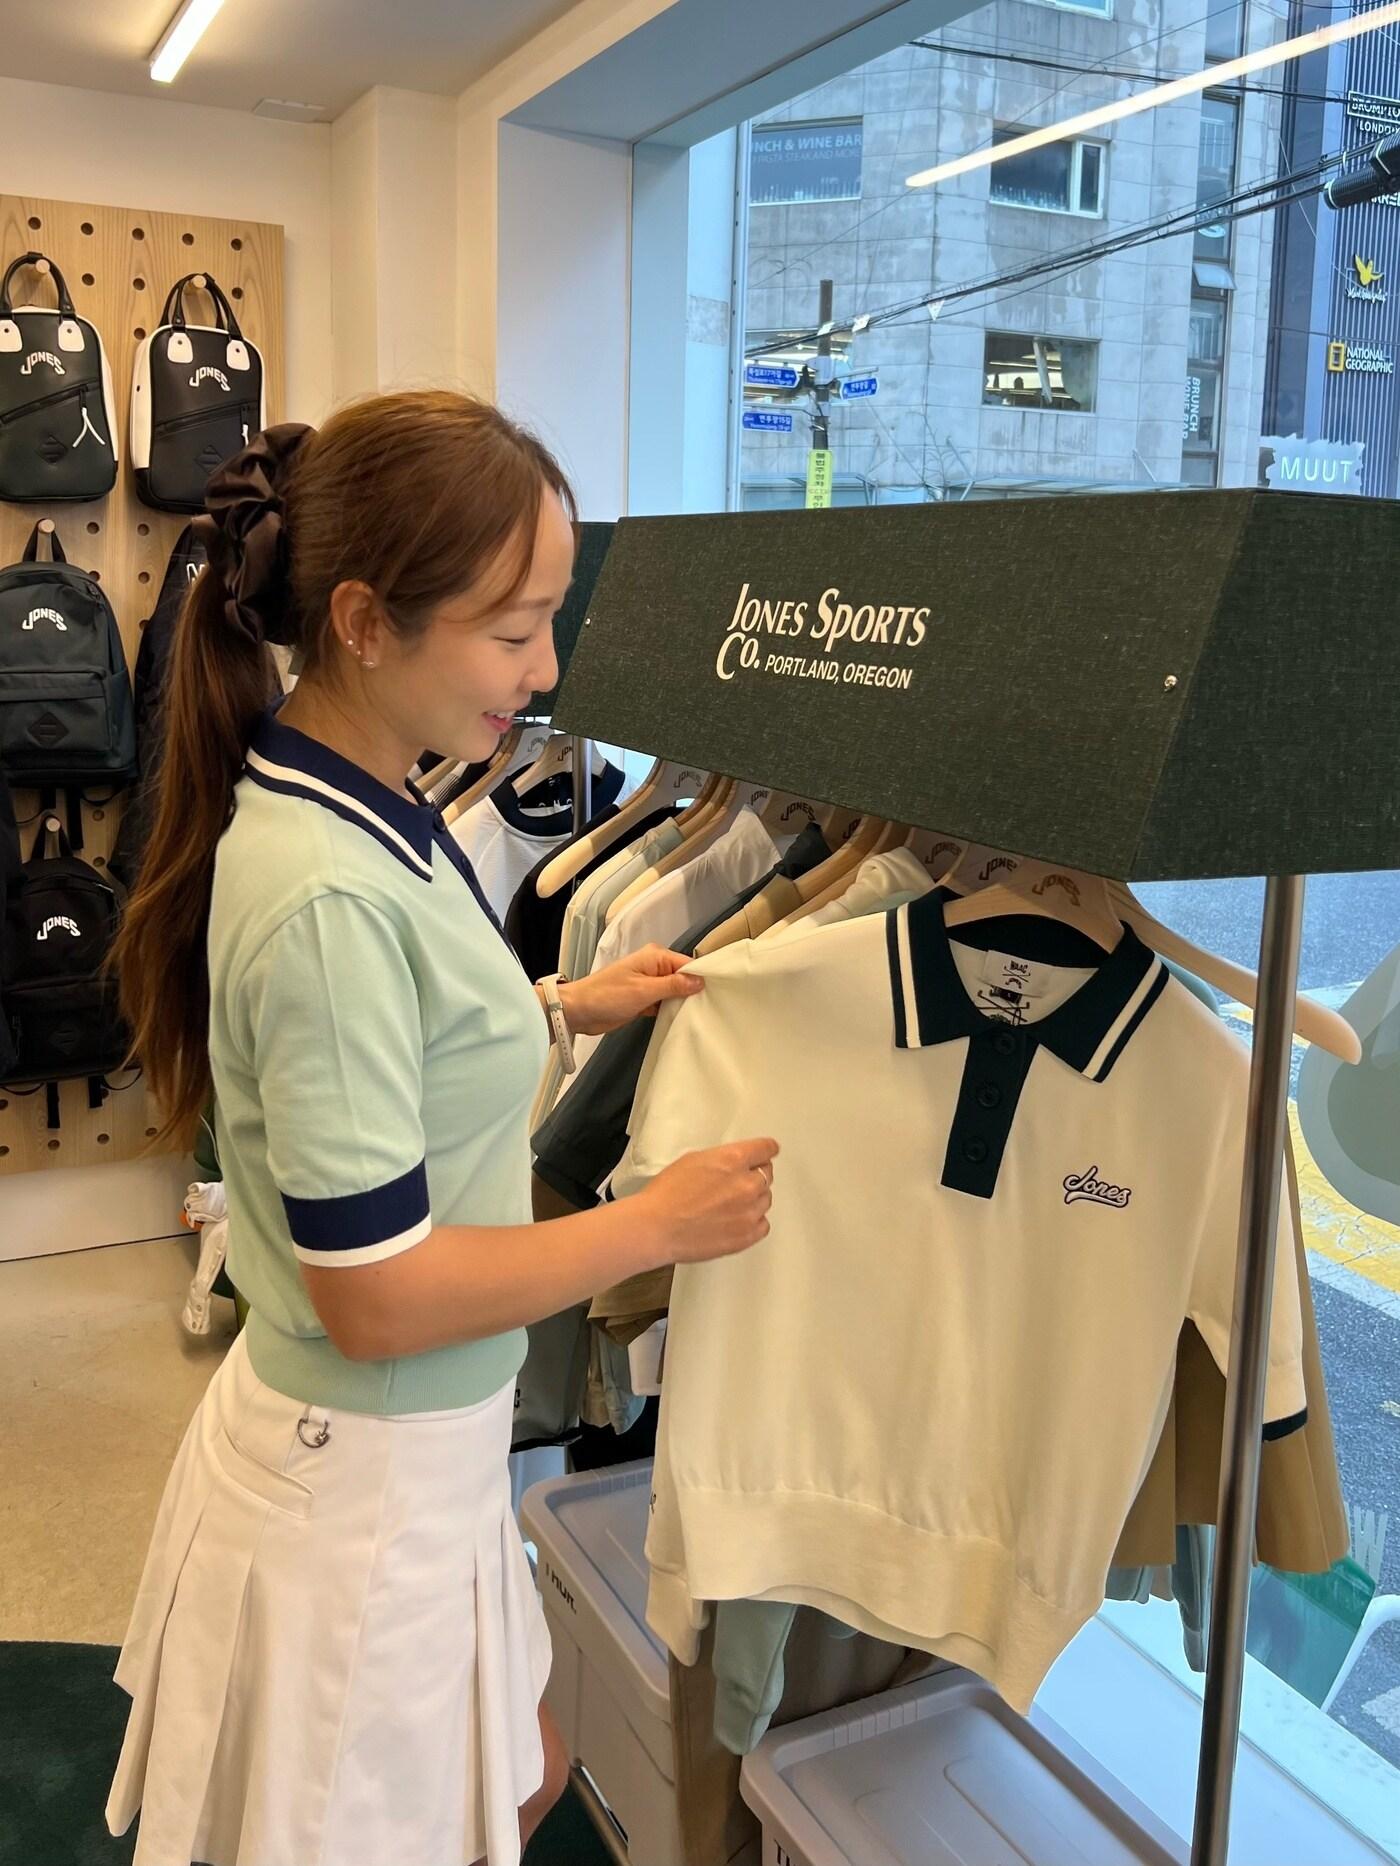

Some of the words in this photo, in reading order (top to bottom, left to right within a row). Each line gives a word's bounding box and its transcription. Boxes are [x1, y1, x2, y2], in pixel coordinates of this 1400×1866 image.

[784, 139, 795, 151] &
[798, 135, 833, 149] WINE
[835, 133, 862, 147] BAR
[21, 351, 66, 375] JONES
[1345, 358, 1394, 374] GEOGRAPHIC
[1346, 346, 1385, 360] NATIONAL
[188, 366, 231, 392] JONES
[1189, 376, 1201, 432] BRUNCH
[1280, 455, 1353, 484] MUUT
[22, 607, 68, 631] JONES
[727, 583, 808, 637] JONES
[764, 654, 840, 685] PORTLAND,
[842, 663, 913, 690] OREGON
[780, 801, 817, 822] JONES
[1031, 873, 1081, 907] JONES
[36, 915, 81, 941] JONES
[1063, 1165, 1132, 1207] Jones
